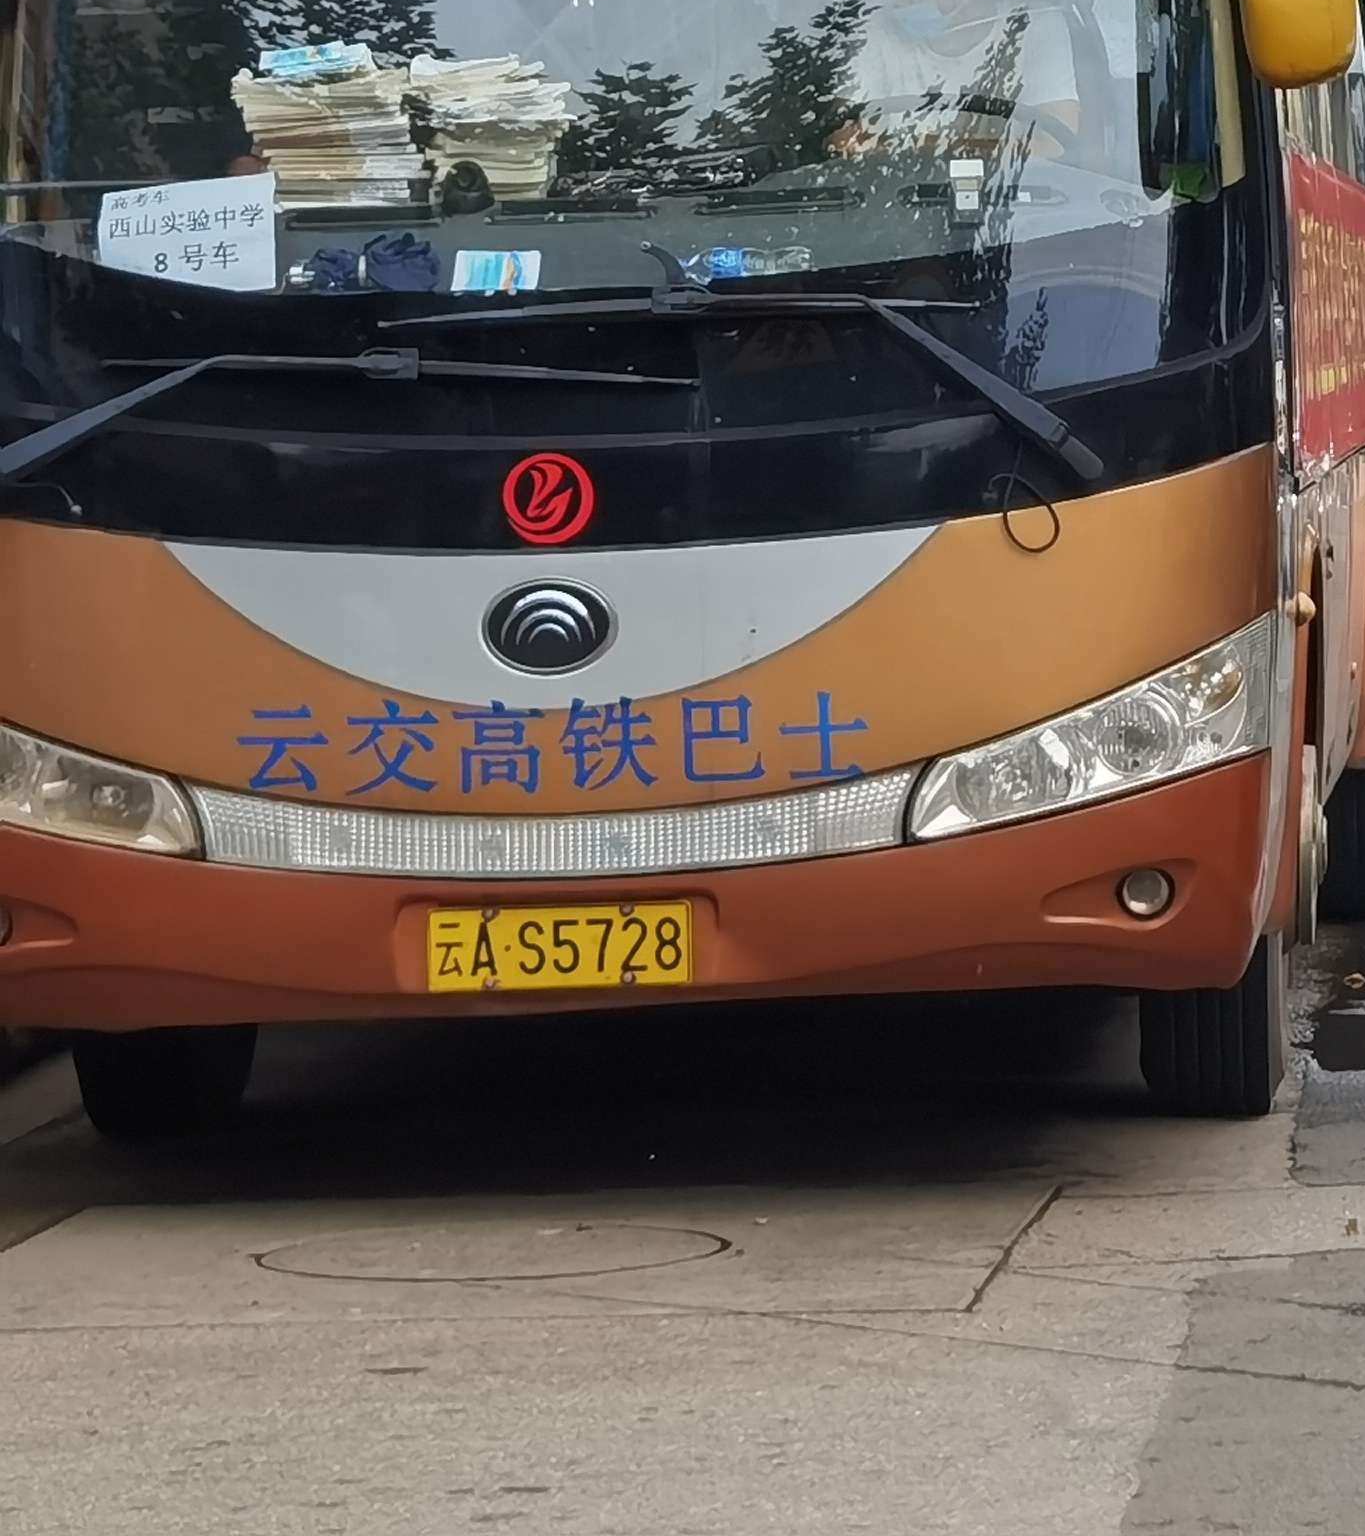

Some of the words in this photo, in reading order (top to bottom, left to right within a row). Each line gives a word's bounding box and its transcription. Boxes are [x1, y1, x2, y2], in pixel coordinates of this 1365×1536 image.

[109, 203, 264, 239] 西山实验中学
[236, 691, 868, 796] 云交高铁巴士
